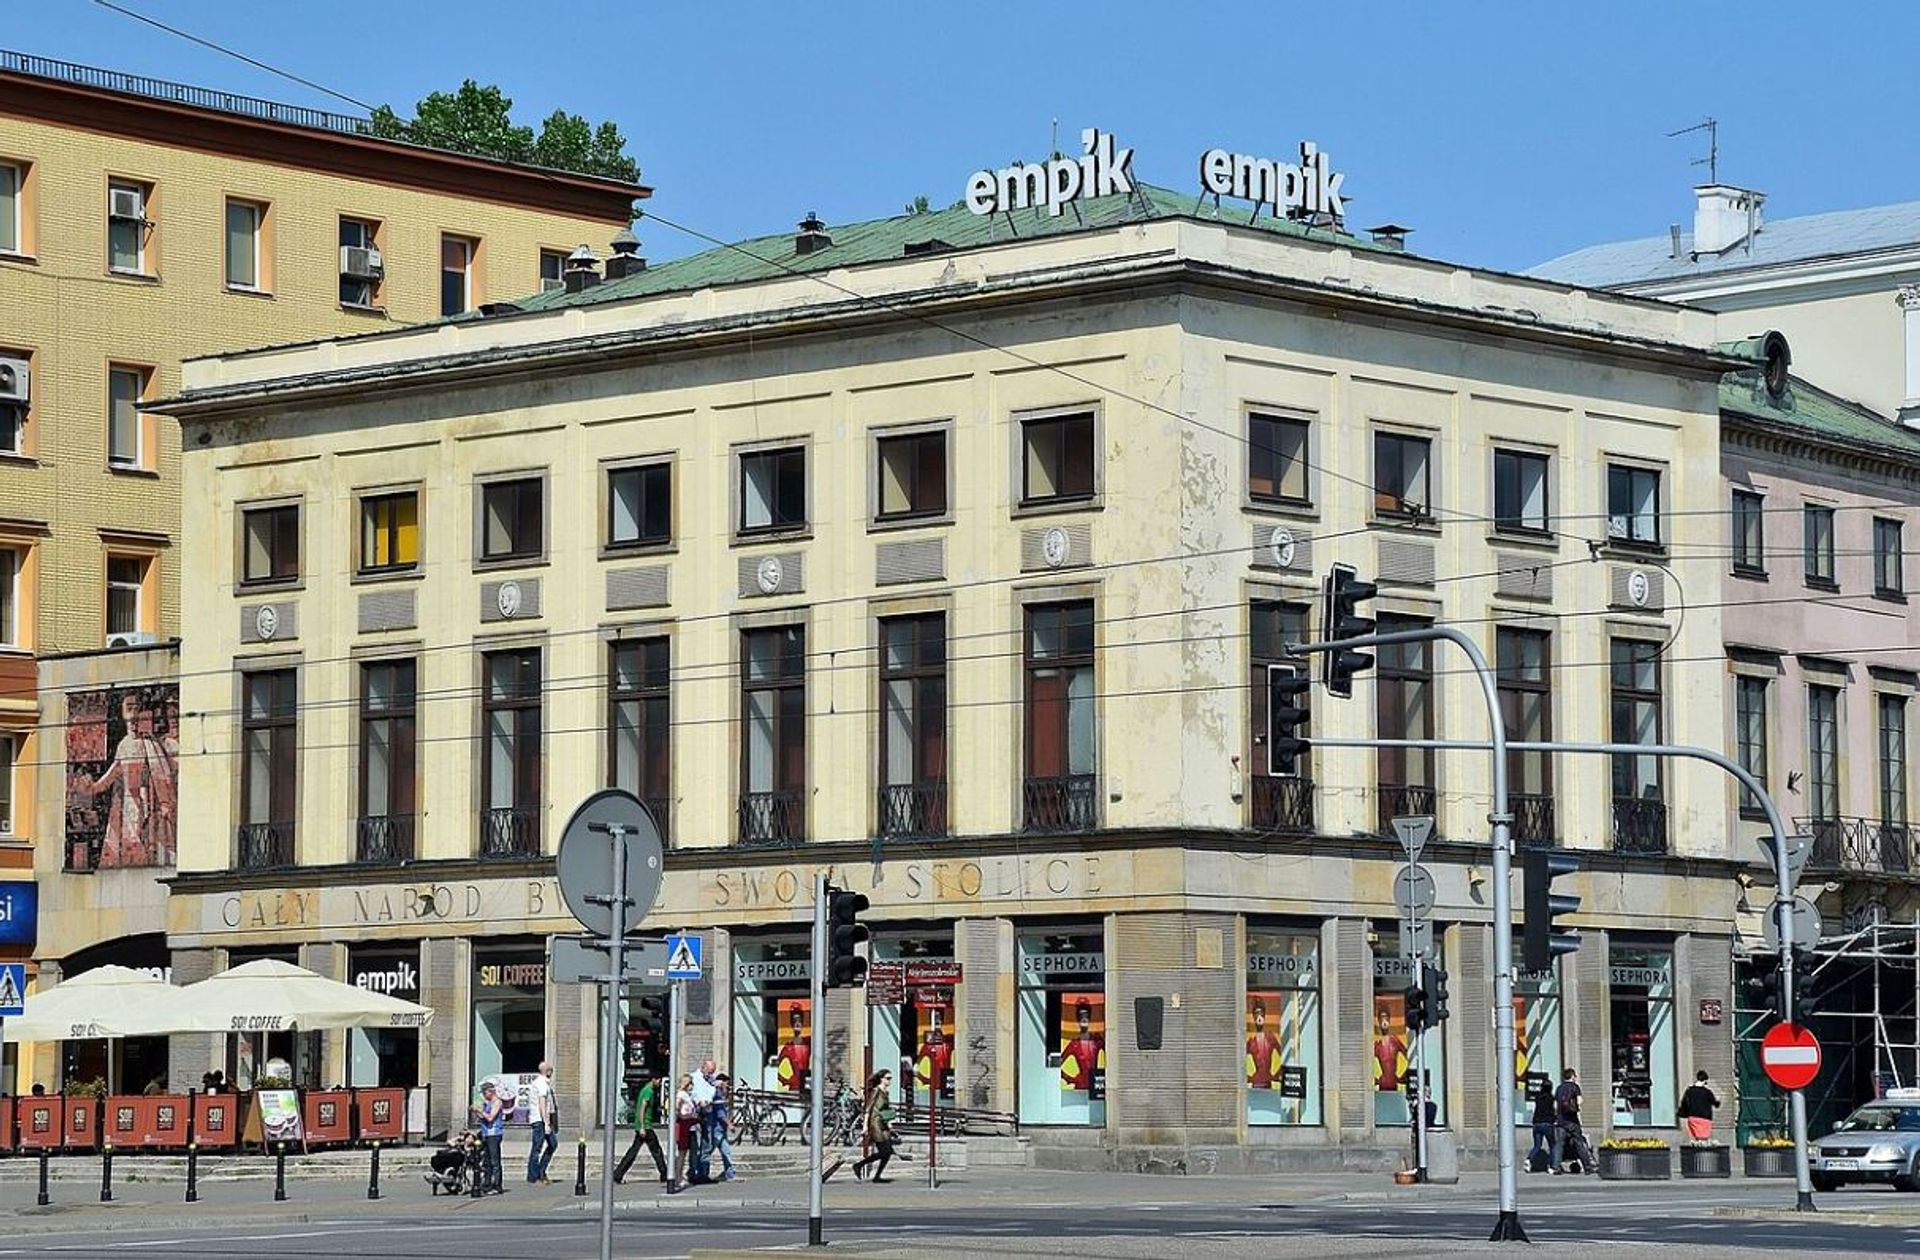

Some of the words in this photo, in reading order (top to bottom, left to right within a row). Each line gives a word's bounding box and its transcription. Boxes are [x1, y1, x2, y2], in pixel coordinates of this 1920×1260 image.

[966, 127, 1134, 217] empik
[1202, 141, 1346, 219] empik
[222, 892, 310, 927] CAŁY
[739, 963, 807, 979] SEPHORA
[1024, 955, 1099, 972] SEPHORA
[356, 961, 416, 994] empik
[481, 965, 500, 986] SO!
[503, 964, 543, 985] COFFEE
[1613, 969, 1668, 984] SEPHORA
[231, 1016, 247, 1029] SO!
[249, 1015, 282, 1029] COFFEE
[209, 1108, 222, 1122] SO!
